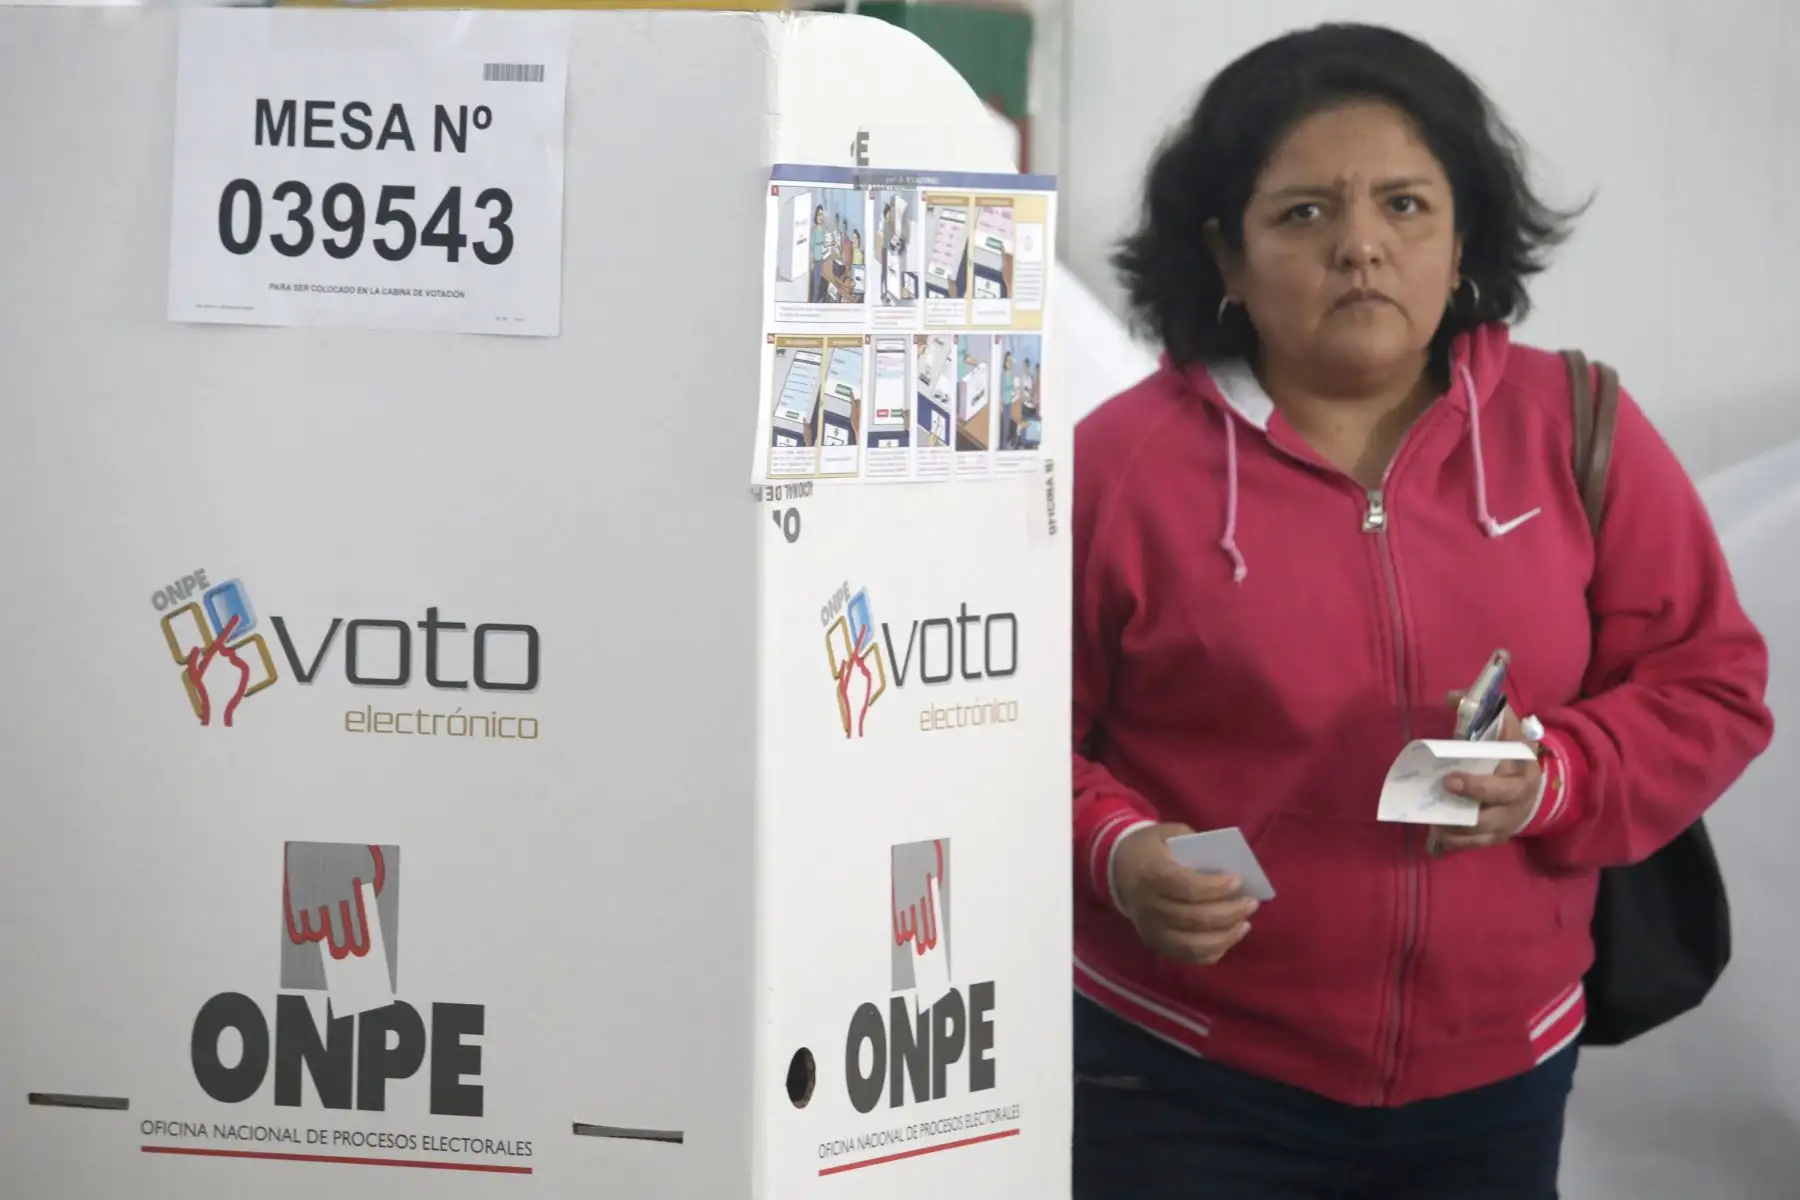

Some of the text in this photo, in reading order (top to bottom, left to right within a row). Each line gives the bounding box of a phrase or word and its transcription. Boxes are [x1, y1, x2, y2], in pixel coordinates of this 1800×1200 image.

[254, 98, 416, 152] MESA
[218, 178, 514, 265] 039543
[269, 283, 291, 292] PARA
[293, 284, 309, 293] SER
[311, 285, 355, 294] COLOCADO
[357, 287, 368, 295] EN
[370, 287, 380, 295] LA
[381, 288, 411, 296] CABINA
[413, 289, 423, 297] DE
[151, 568, 211, 612] ONPE
[270, 607, 539, 692] voto
[881, 602, 1018, 687] voto
[345, 704, 538, 740] electrónico
[920, 697, 1018, 732] electrónico
[191, 991, 485, 1117] ONPE
[845, 980, 995, 1114] ONPE
[140, 1119, 533, 1157] OFICINA NACIONAL DE PROCESOS ELECTORALES
[818, 1104, 1020, 1159] OFICINA NACIONAL DE PROCESOS ELECTORALES
